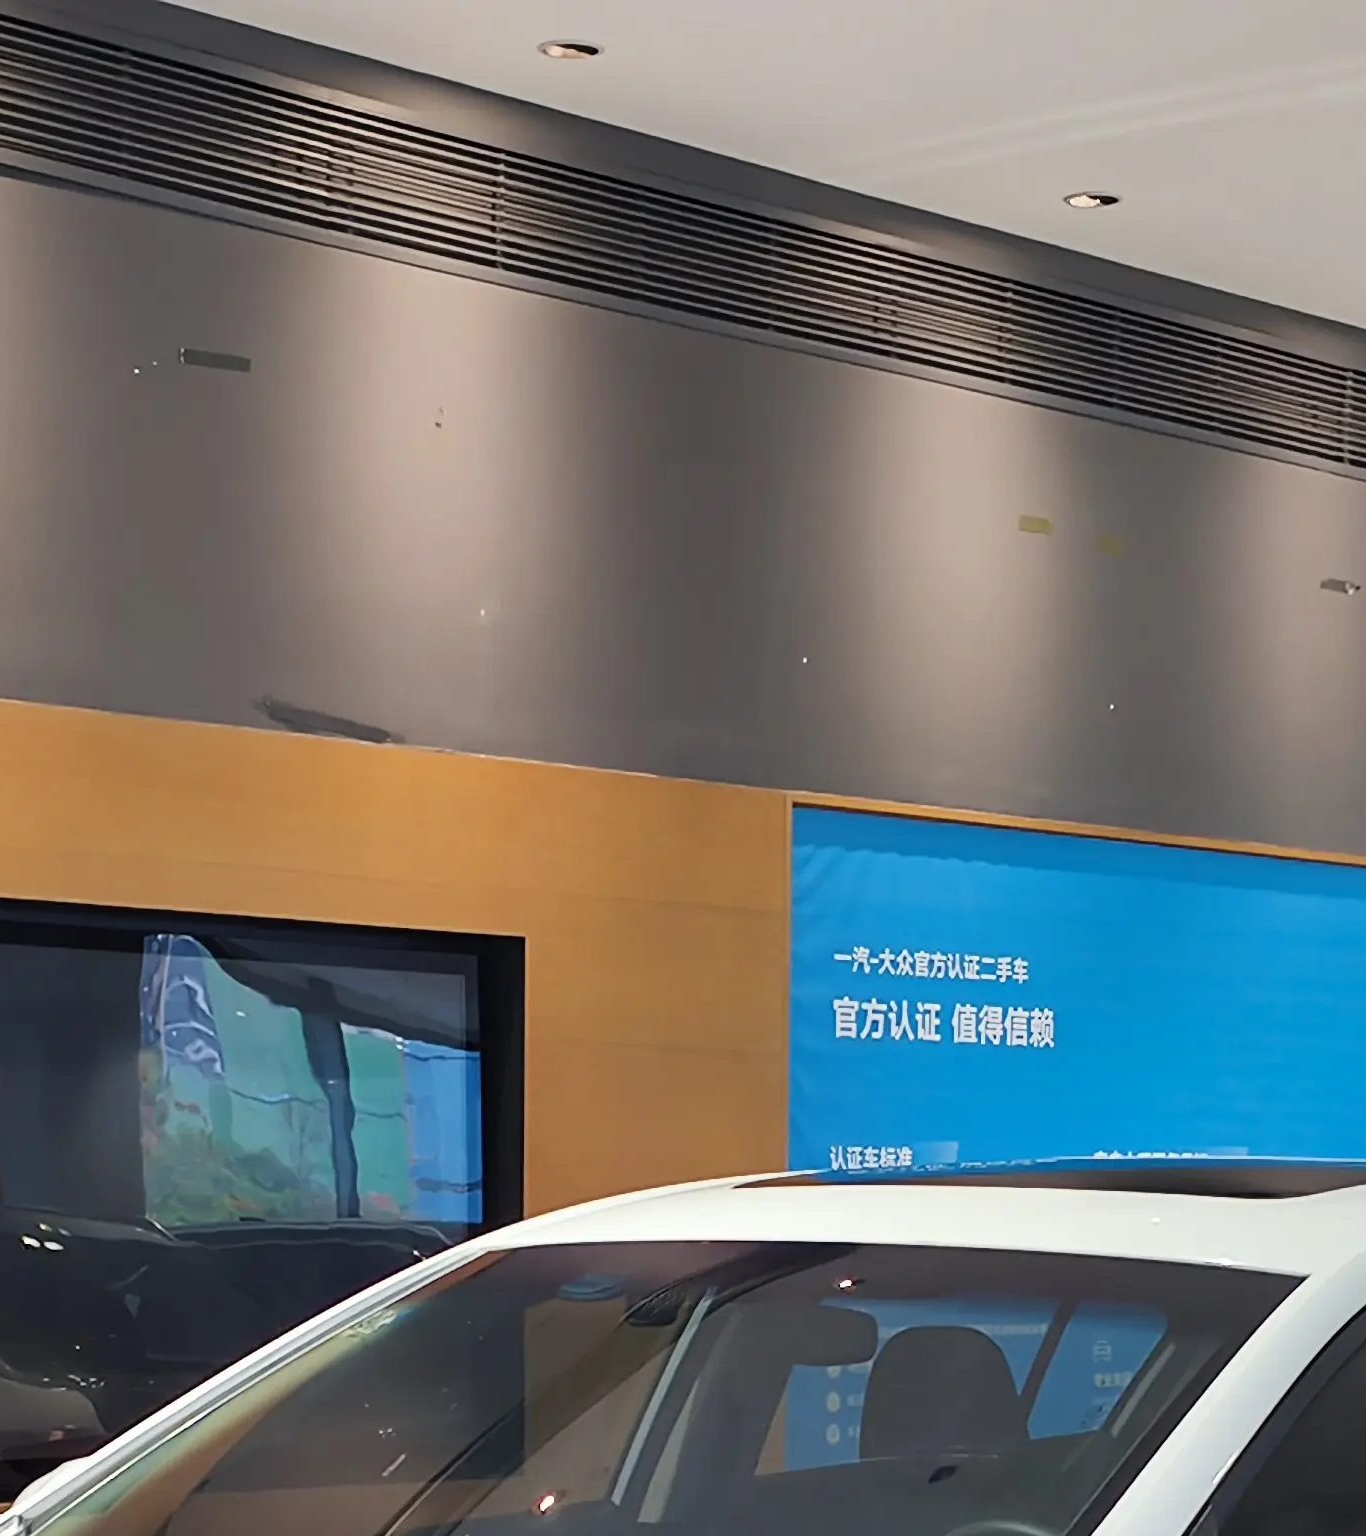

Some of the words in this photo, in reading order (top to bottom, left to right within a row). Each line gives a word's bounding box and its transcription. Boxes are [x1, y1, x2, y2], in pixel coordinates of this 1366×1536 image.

[833, 946, 1029, 985] 一汽-大众官方认证二手车
[832, 996, 942, 1043] 官方认证
[951, 1002, 1056, 1049] 值得信赖
[829, 1145, 914, 1171] 认证车标准
